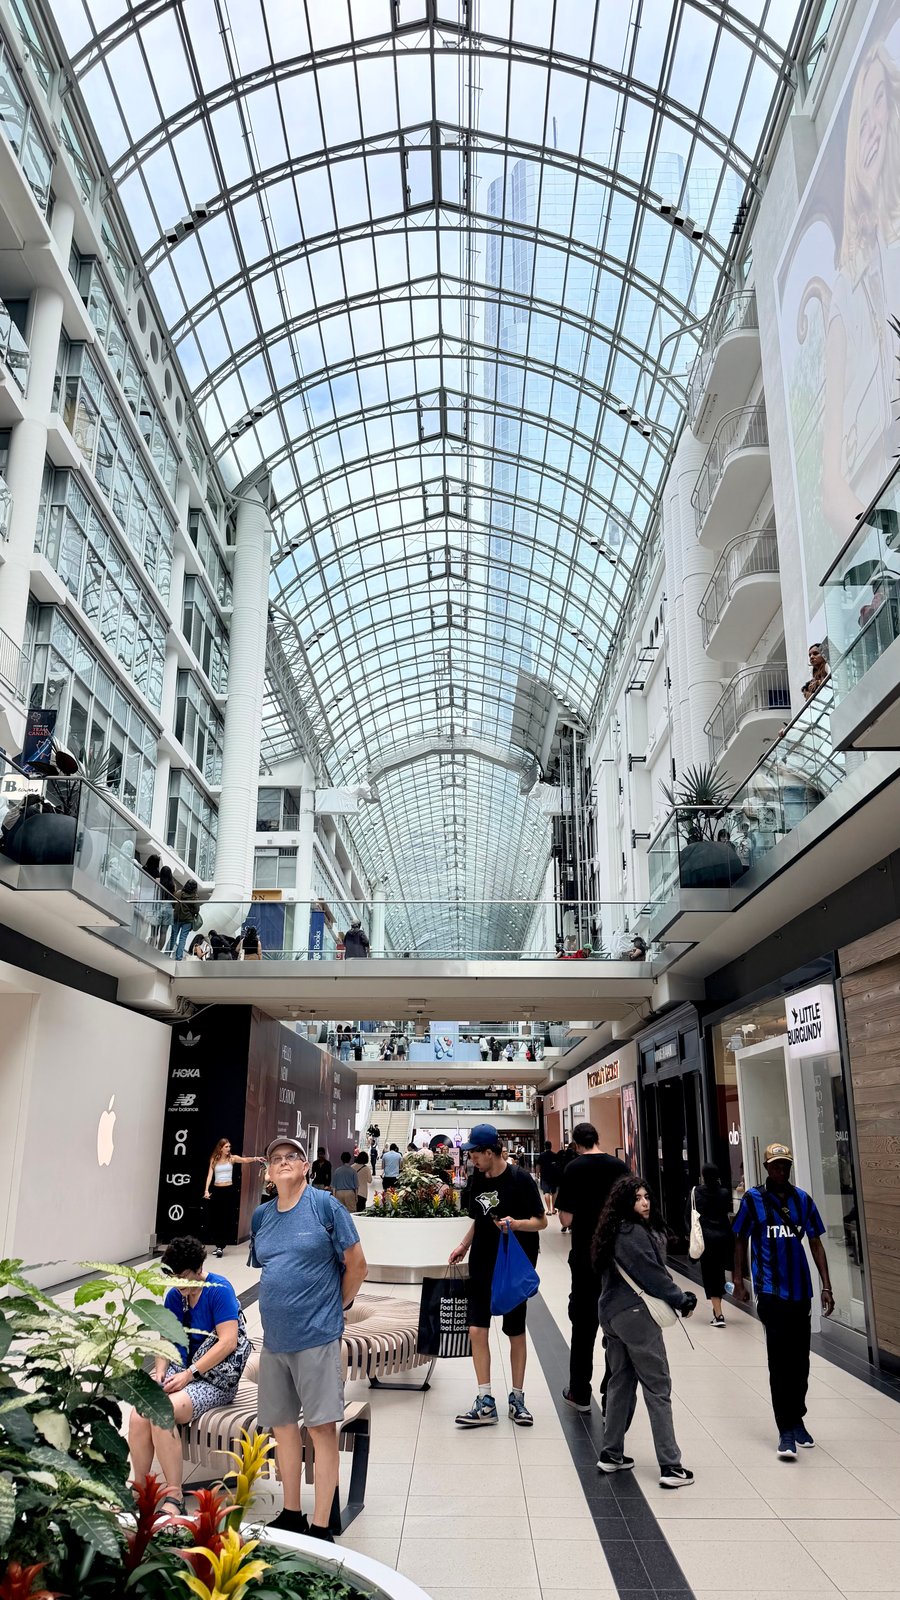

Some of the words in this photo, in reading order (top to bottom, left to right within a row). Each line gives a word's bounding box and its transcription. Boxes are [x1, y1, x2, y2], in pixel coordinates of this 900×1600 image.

[313, 930, 321, 950] Books
[798, 1002, 821, 1024] LITTLE
[787, 1021, 822, 1046] BURGUNDY
[171, 1068, 201, 1078] HOKA
[166, 1173, 191, 1186] UGG
